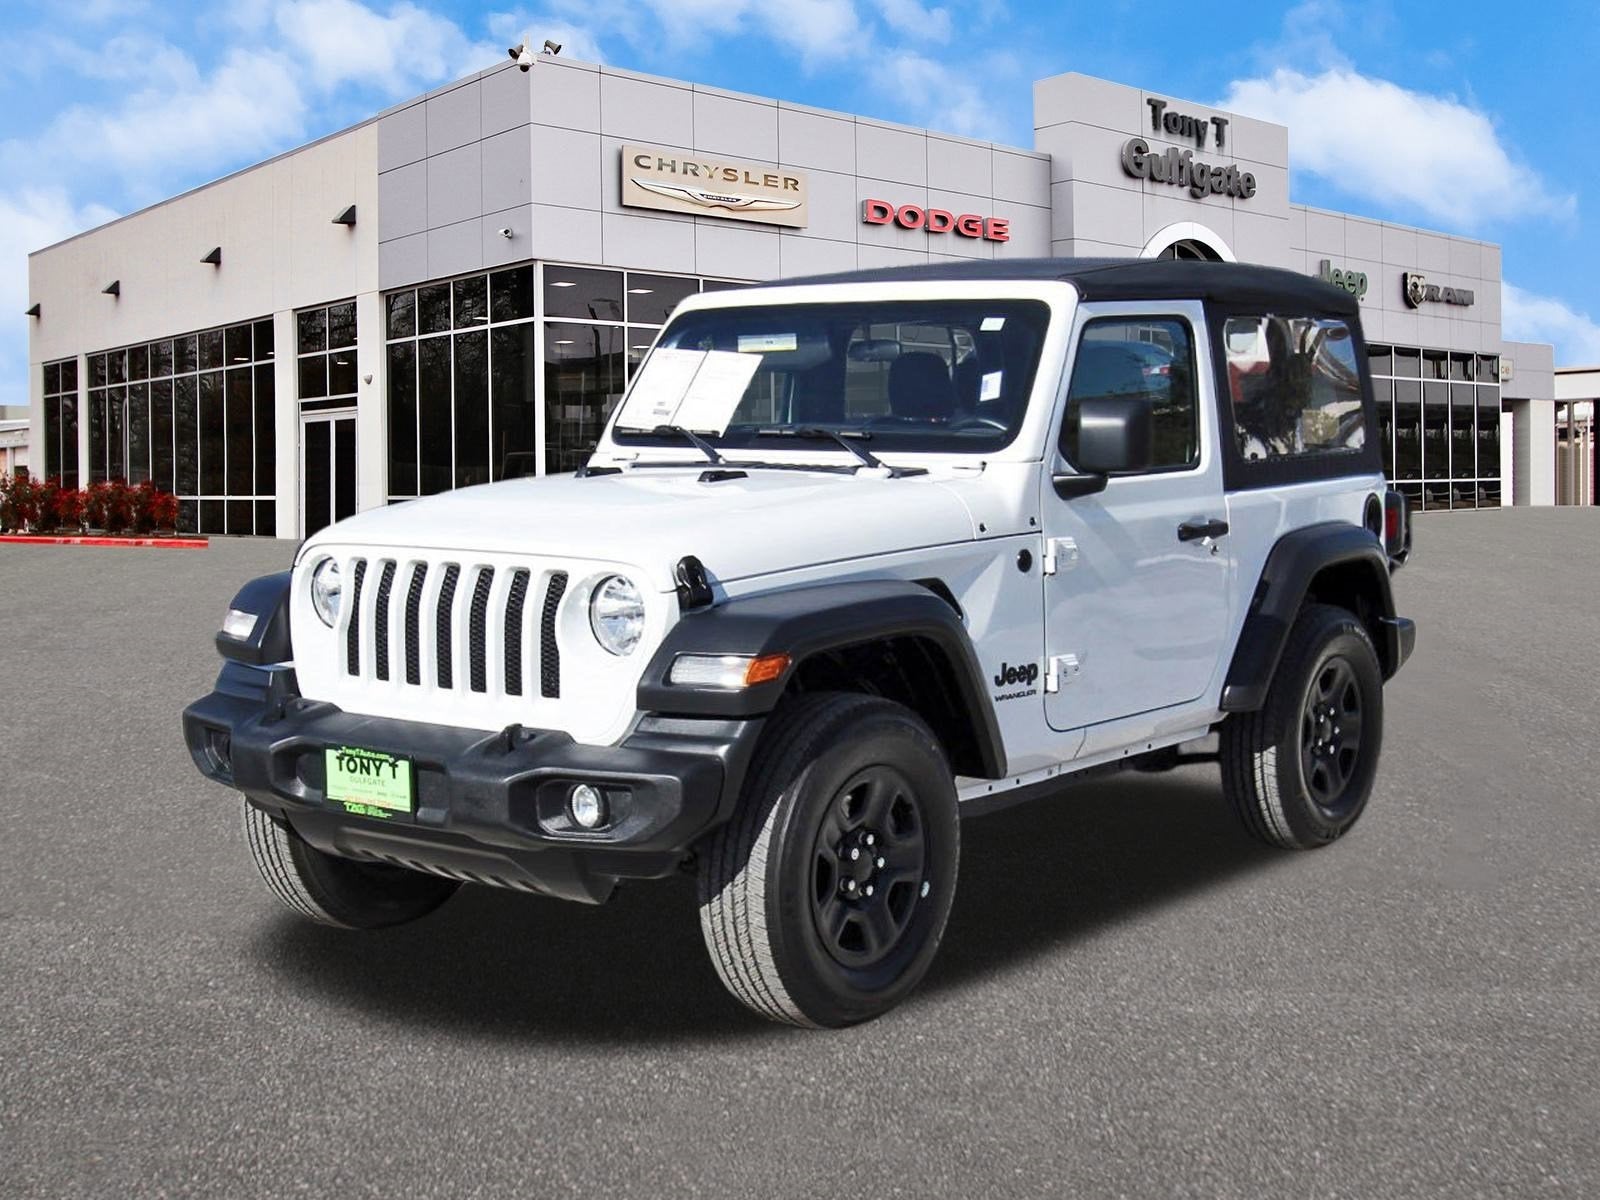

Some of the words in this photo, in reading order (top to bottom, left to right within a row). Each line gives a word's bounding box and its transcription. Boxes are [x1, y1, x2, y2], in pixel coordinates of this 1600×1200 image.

[1147, 98, 1208, 147] Tony
[1210, 116, 1229, 148] T
[633, 154, 800, 192] CHRYSLER
[1121, 138, 1256, 199] Gulfgate
[863, 199, 1010, 242] DODGE
[1425, 284, 1475, 307] RAM
[995, 662, 1038, 687] Jeep
[994, 689, 1037, 702] WRANGLER
[335, 753, 383, 777] TONY
[388, 760, 399, 779] T
